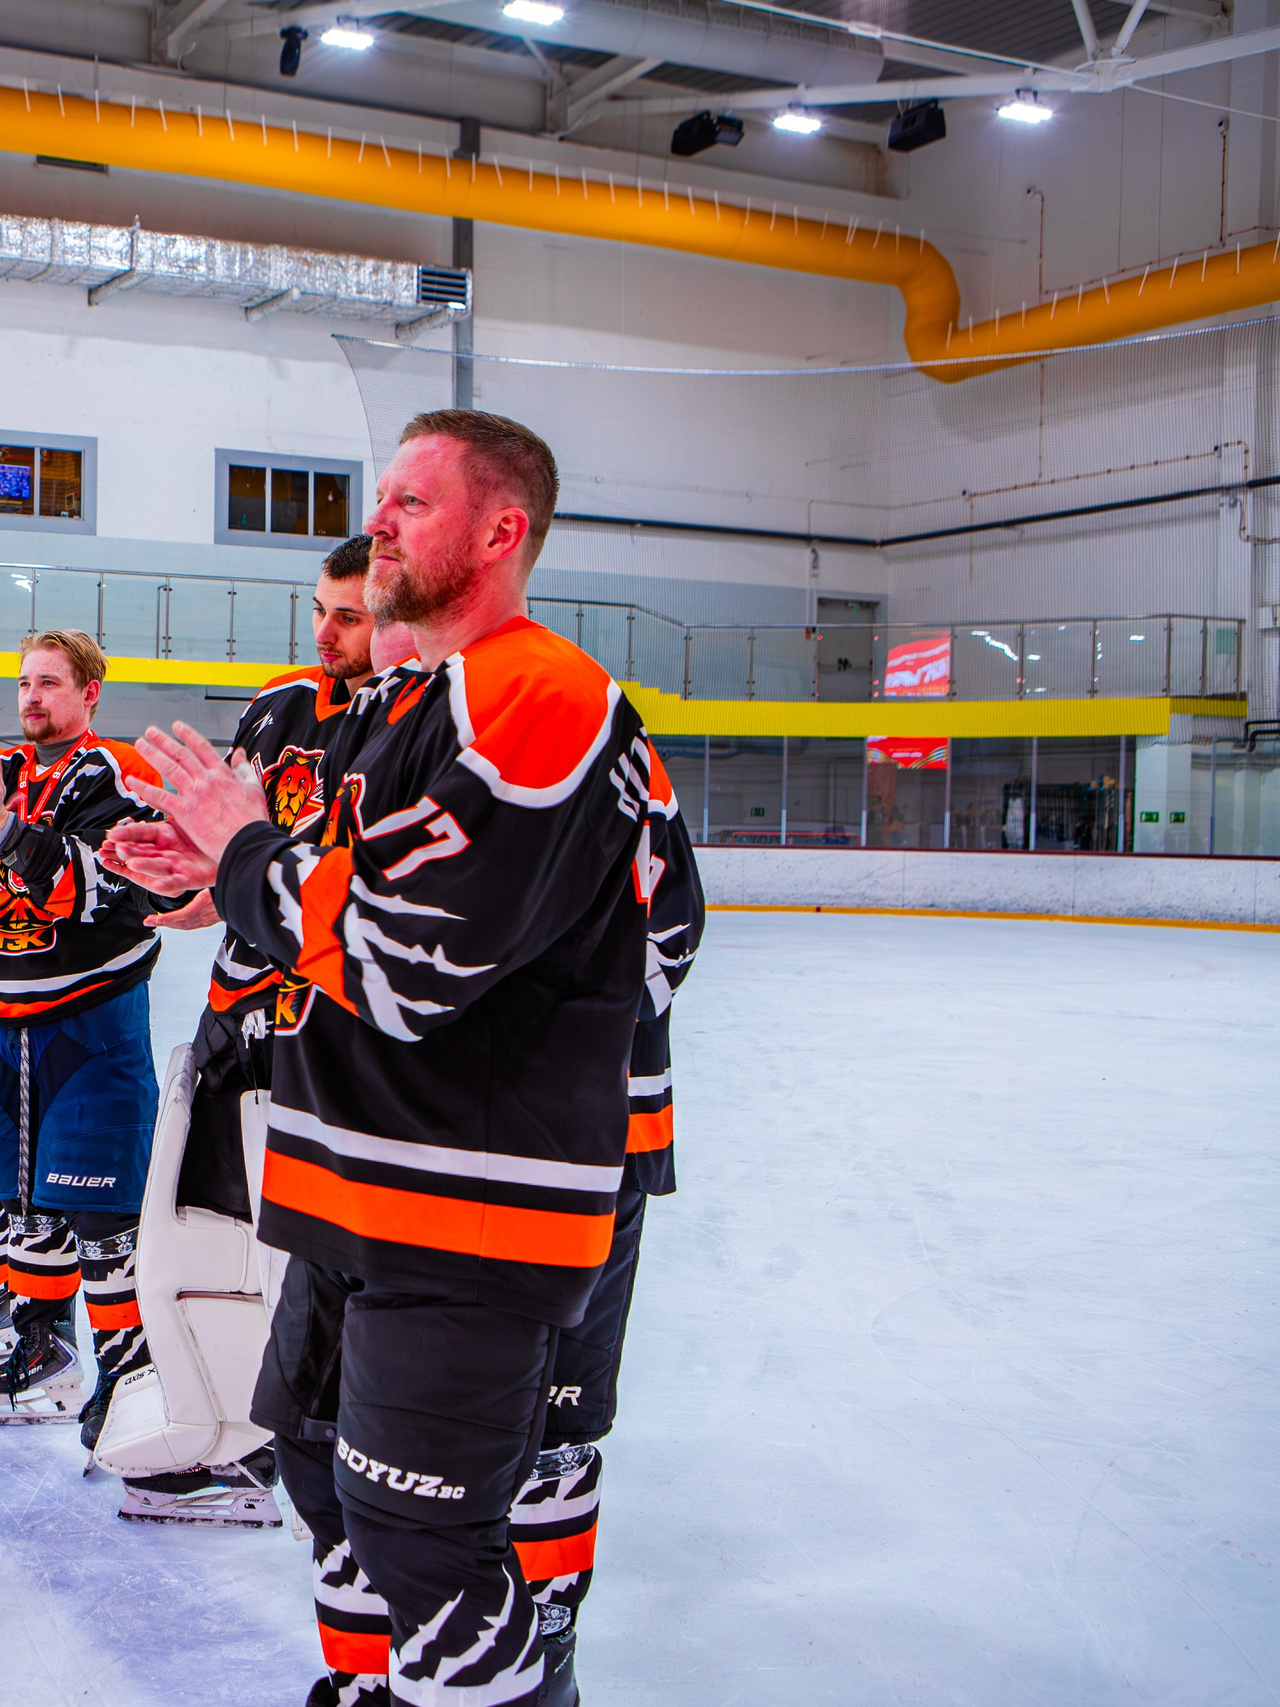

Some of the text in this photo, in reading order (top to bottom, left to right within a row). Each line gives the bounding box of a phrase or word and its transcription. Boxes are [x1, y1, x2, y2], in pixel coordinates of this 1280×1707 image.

[361, 796, 471, 883] 17
[336, 1436, 466, 1500] SOYUZ BC
